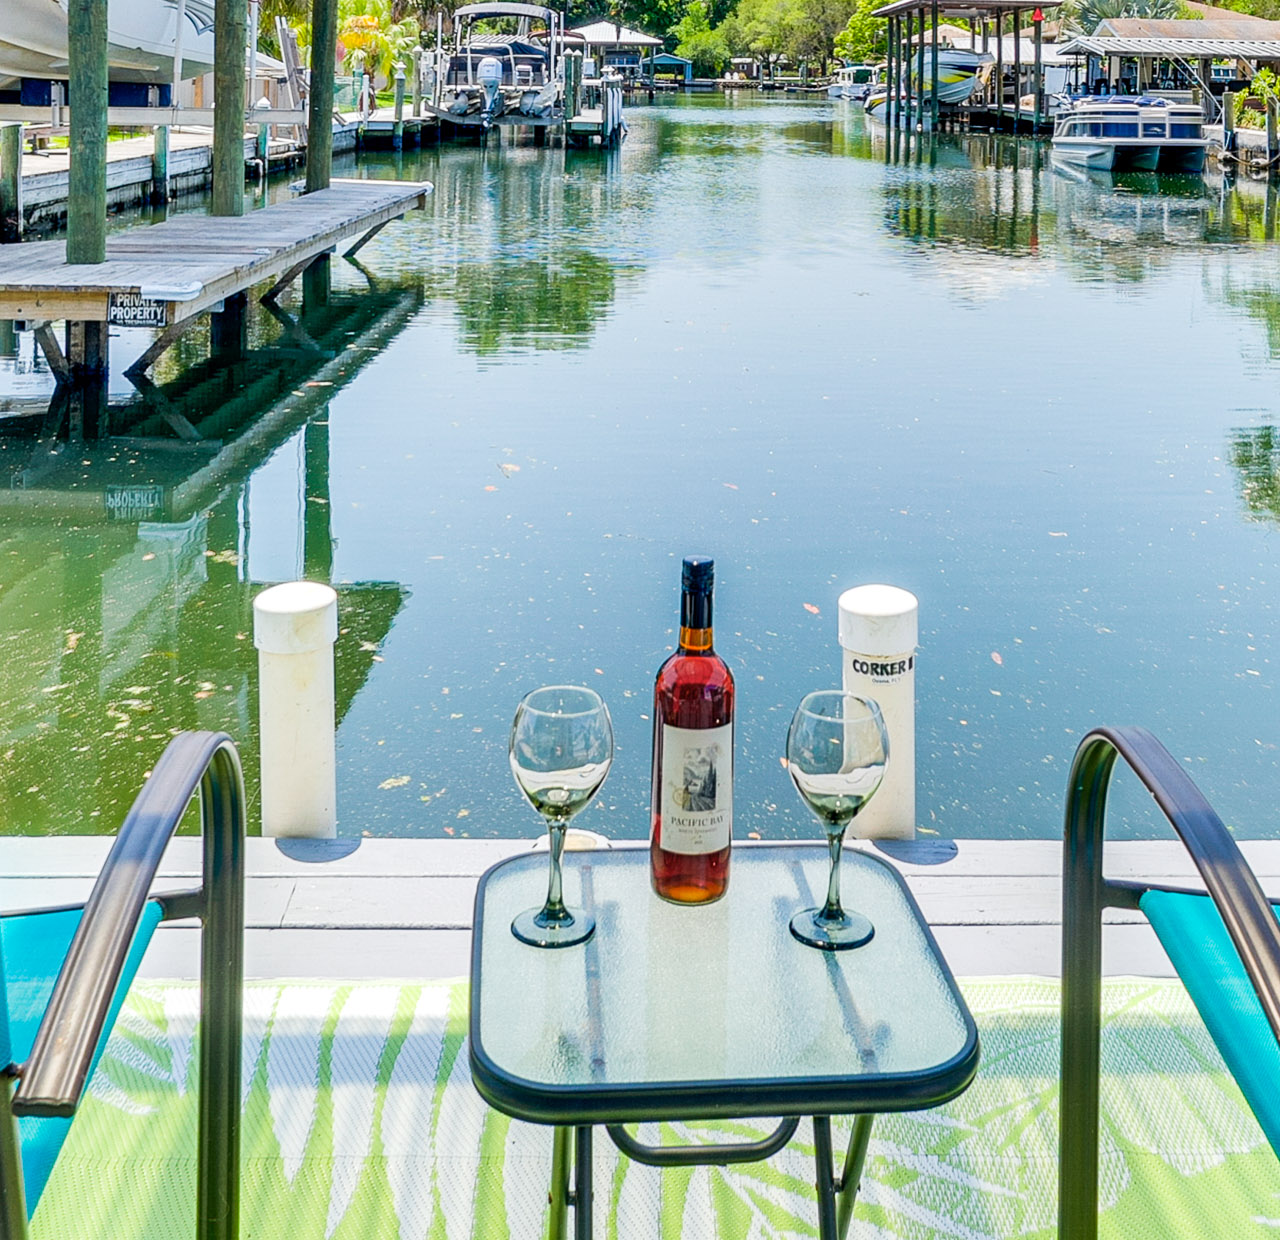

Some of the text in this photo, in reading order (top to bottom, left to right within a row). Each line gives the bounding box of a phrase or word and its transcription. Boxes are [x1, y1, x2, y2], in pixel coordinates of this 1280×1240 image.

[110, 306, 163, 320] PROPERTY
[852, 658, 906, 676] CORKER
[671, 816, 708, 827] PACIFIC
